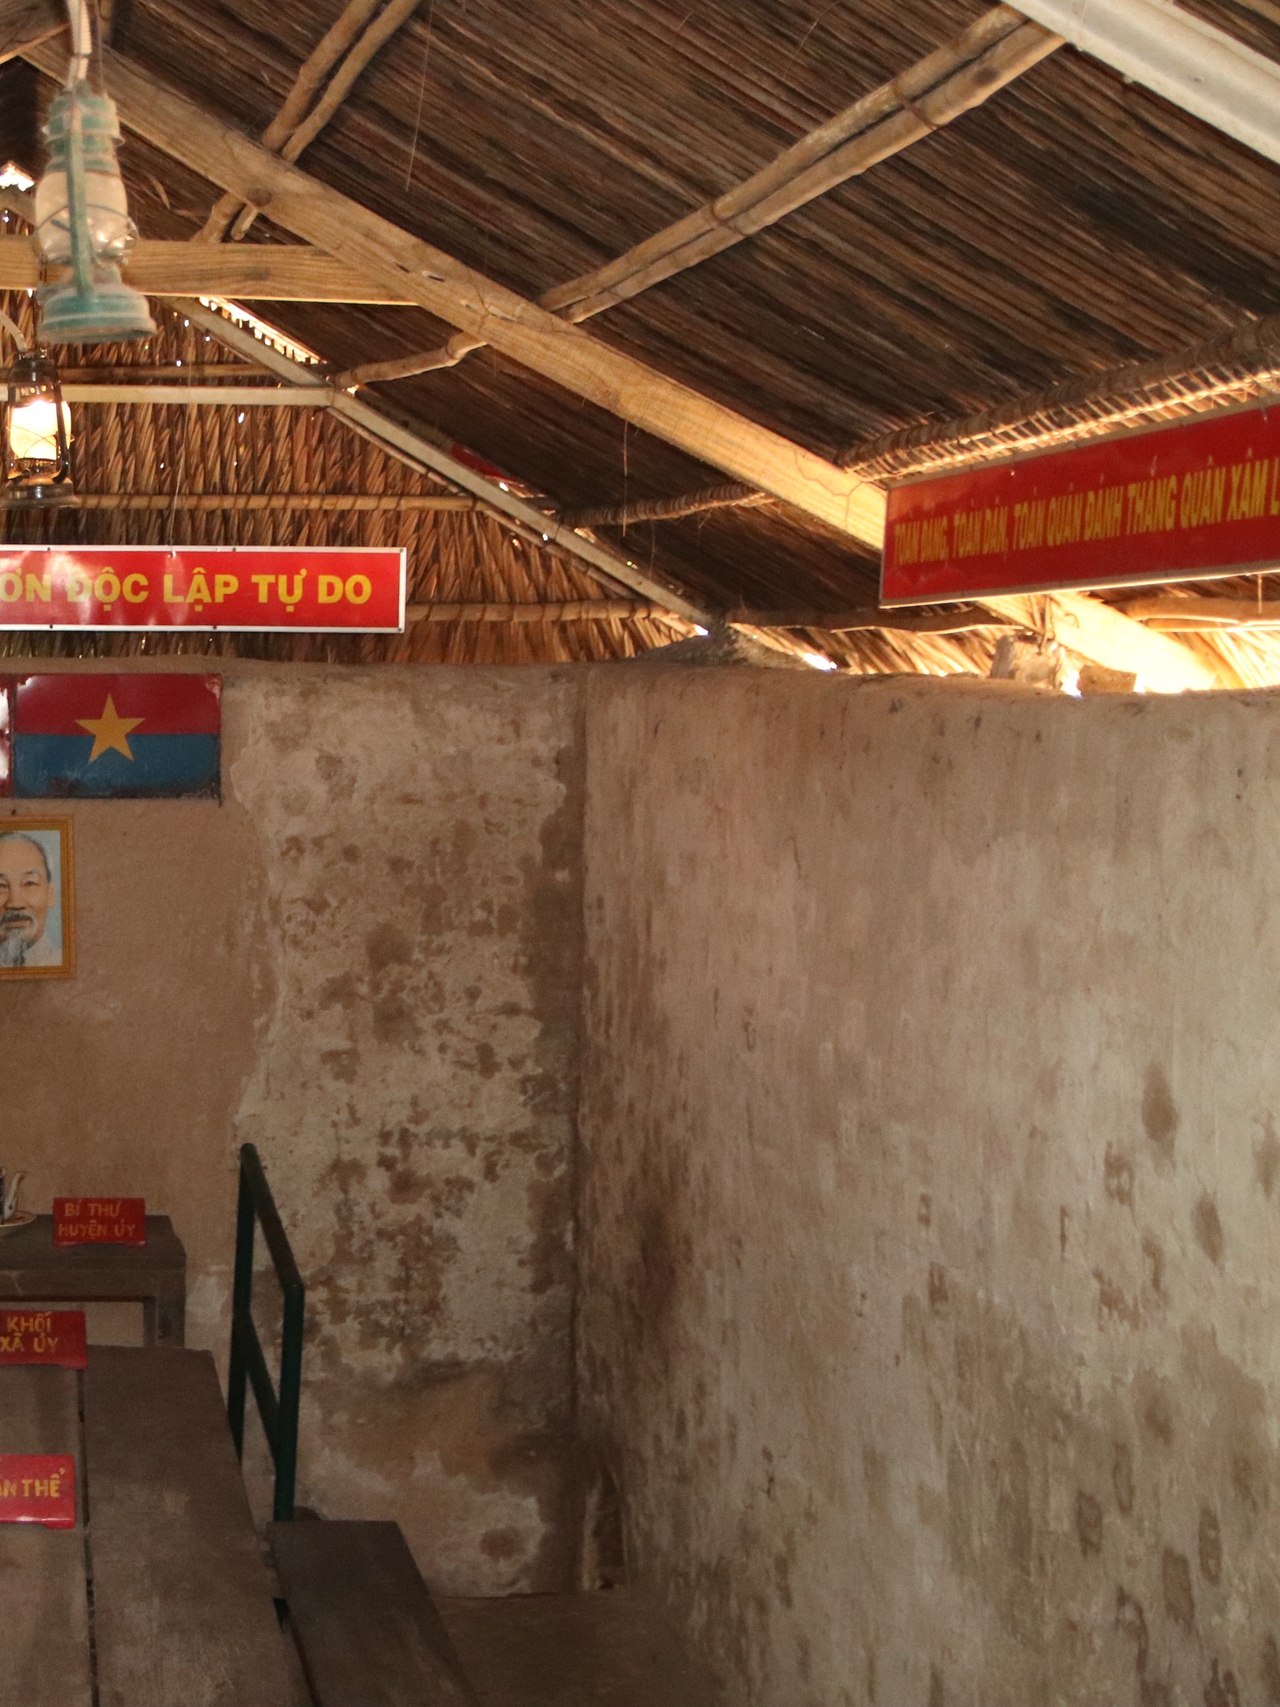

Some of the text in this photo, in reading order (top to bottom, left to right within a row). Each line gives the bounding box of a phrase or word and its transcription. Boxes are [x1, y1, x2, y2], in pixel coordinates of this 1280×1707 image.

[1181, 455, 1226, 528] QUÂN
[1227, 447, 1269, 521] XÂM
[65, 567, 148, 612] ĐỘC
[163, 567, 239, 612] LẬP
[251, 568, 307, 612] TỰ
[318, 574, 372, 605] DO
[64, 1199, 83, 1217] BÍ
[6, 1311, 52, 1332] KHỐI
[0, 1332, 24, 1352] XÃ
[21, 1467, 66, 1498] THỂ
